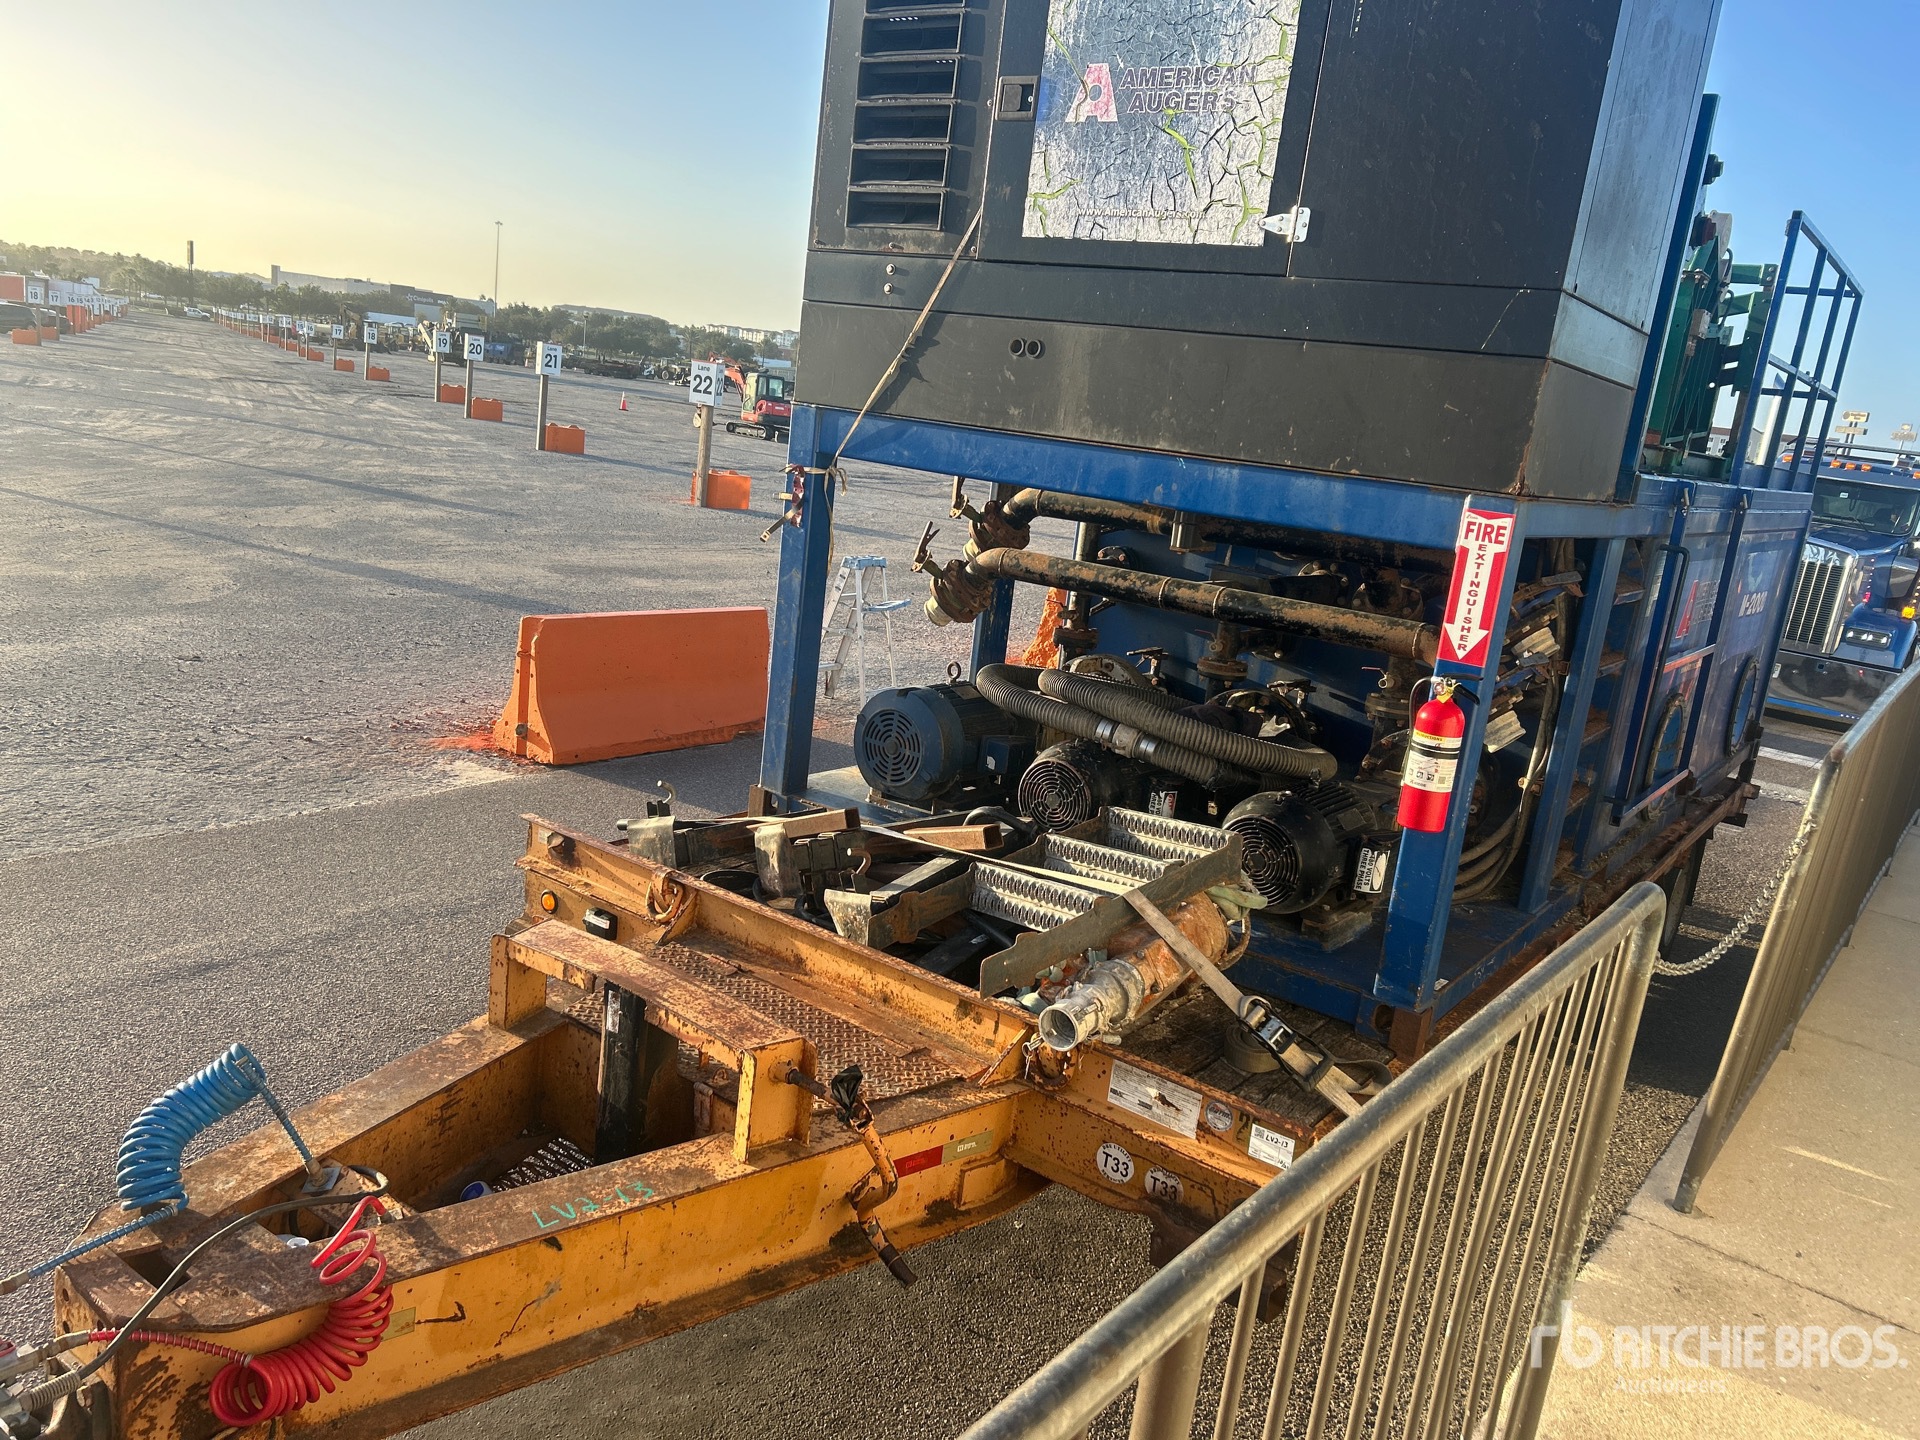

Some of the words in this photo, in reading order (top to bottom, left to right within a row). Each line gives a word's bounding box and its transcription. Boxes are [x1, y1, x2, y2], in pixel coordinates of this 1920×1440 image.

[1119, 64, 1258, 90] AMERICAN
[1126, 89, 1237, 114] AUGERS
[30, 291, 39, 300] 18
[51, 294, 59, 302] 17
[335, 328, 342, 336] 17
[368, 332, 376, 340] 18
[438, 338, 448, 348] 19
[468, 342, 483, 355] 20
[544, 353, 558, 369] 21
[697, 364, 711, 372] Lane
[692, 373, 713, 396] 22
[1463, 520, 1508, 546] FIRE
[1456, 543, 1488, 652] EXTINGUISHER
[1360, 849, 1370, 870] THREE
[1355, 870, 1366, 890] PHASE
[1363, 867, 1374, 887] VOLTS
[1265, 1134, 1289, 1148] LV2-13
[1102, 1150, 1130, 1178] T33
[1150, 1175, 1178, 1201] T33
[532, 1181, 654, 1229] LV2-13
